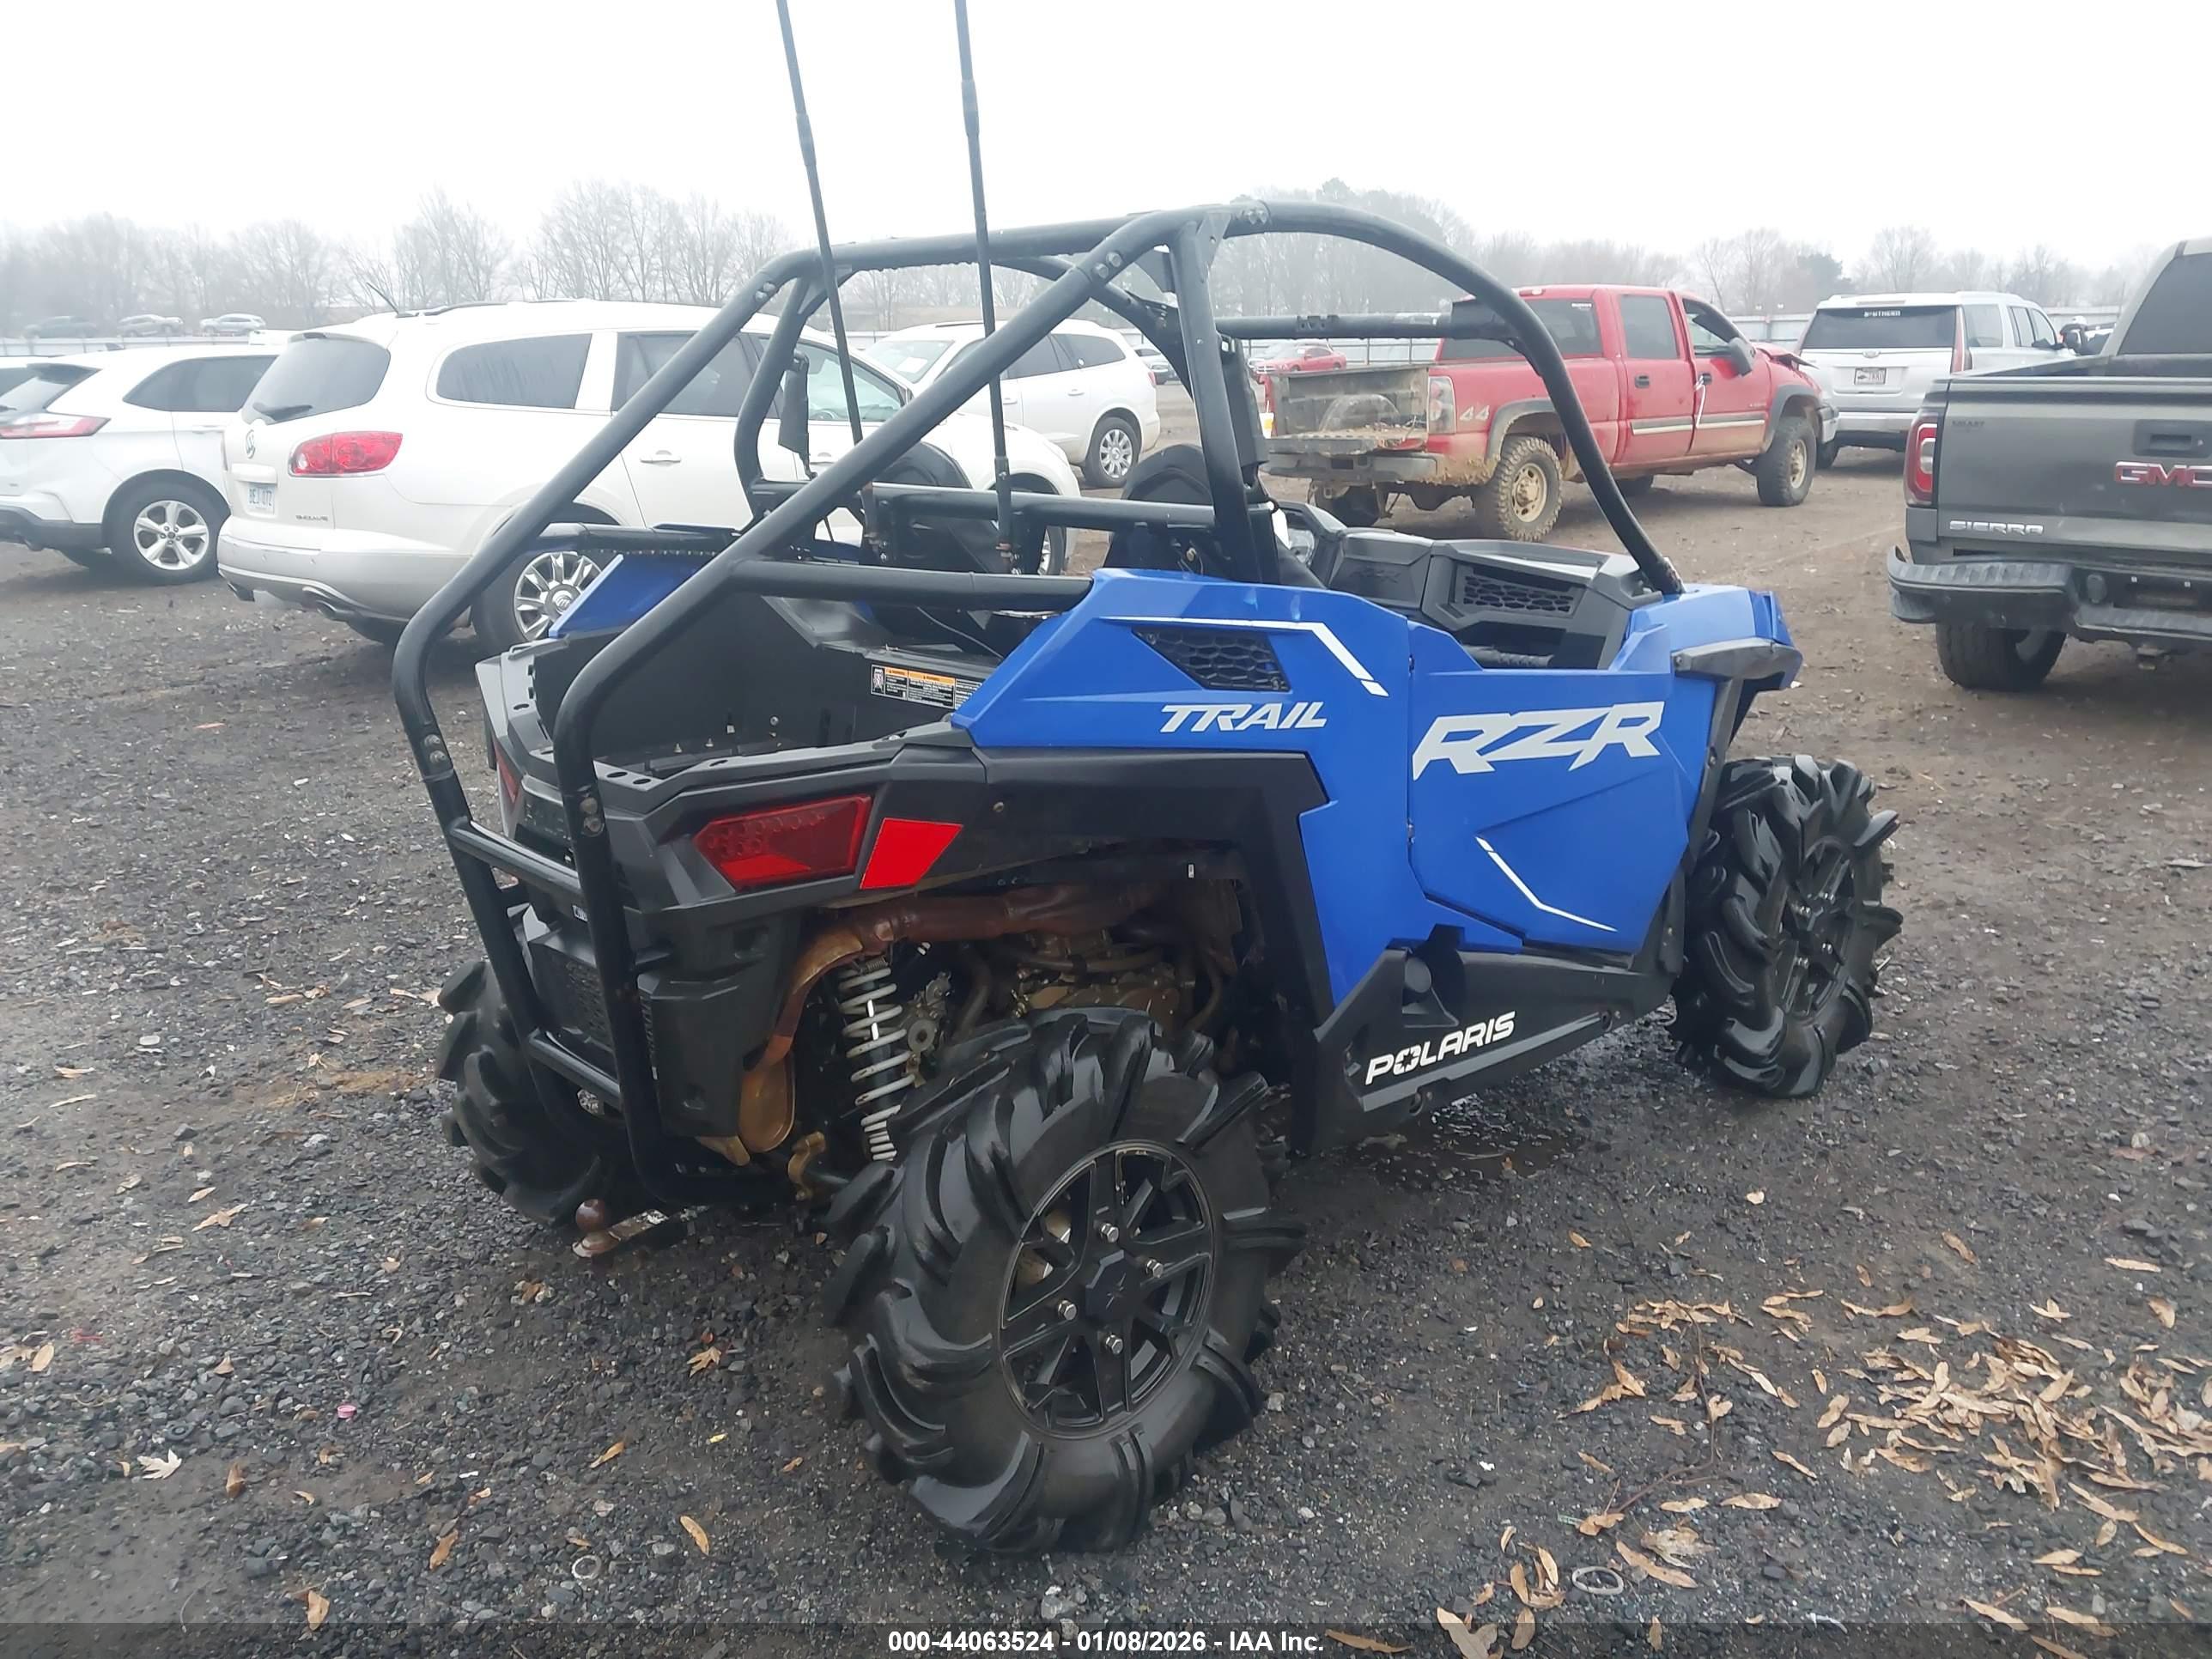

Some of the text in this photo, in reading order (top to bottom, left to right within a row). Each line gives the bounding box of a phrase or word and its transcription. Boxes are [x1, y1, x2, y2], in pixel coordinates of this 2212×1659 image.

[2114, 460, 2212, 488] GMC
[1949, 520, 2044, 536] SIERRA
[1160, 702, 1328, 732] TRAIL
[1412, 701, 1665, 781] RZR
[1364, 1011, 1516, 1085] POLARIS
